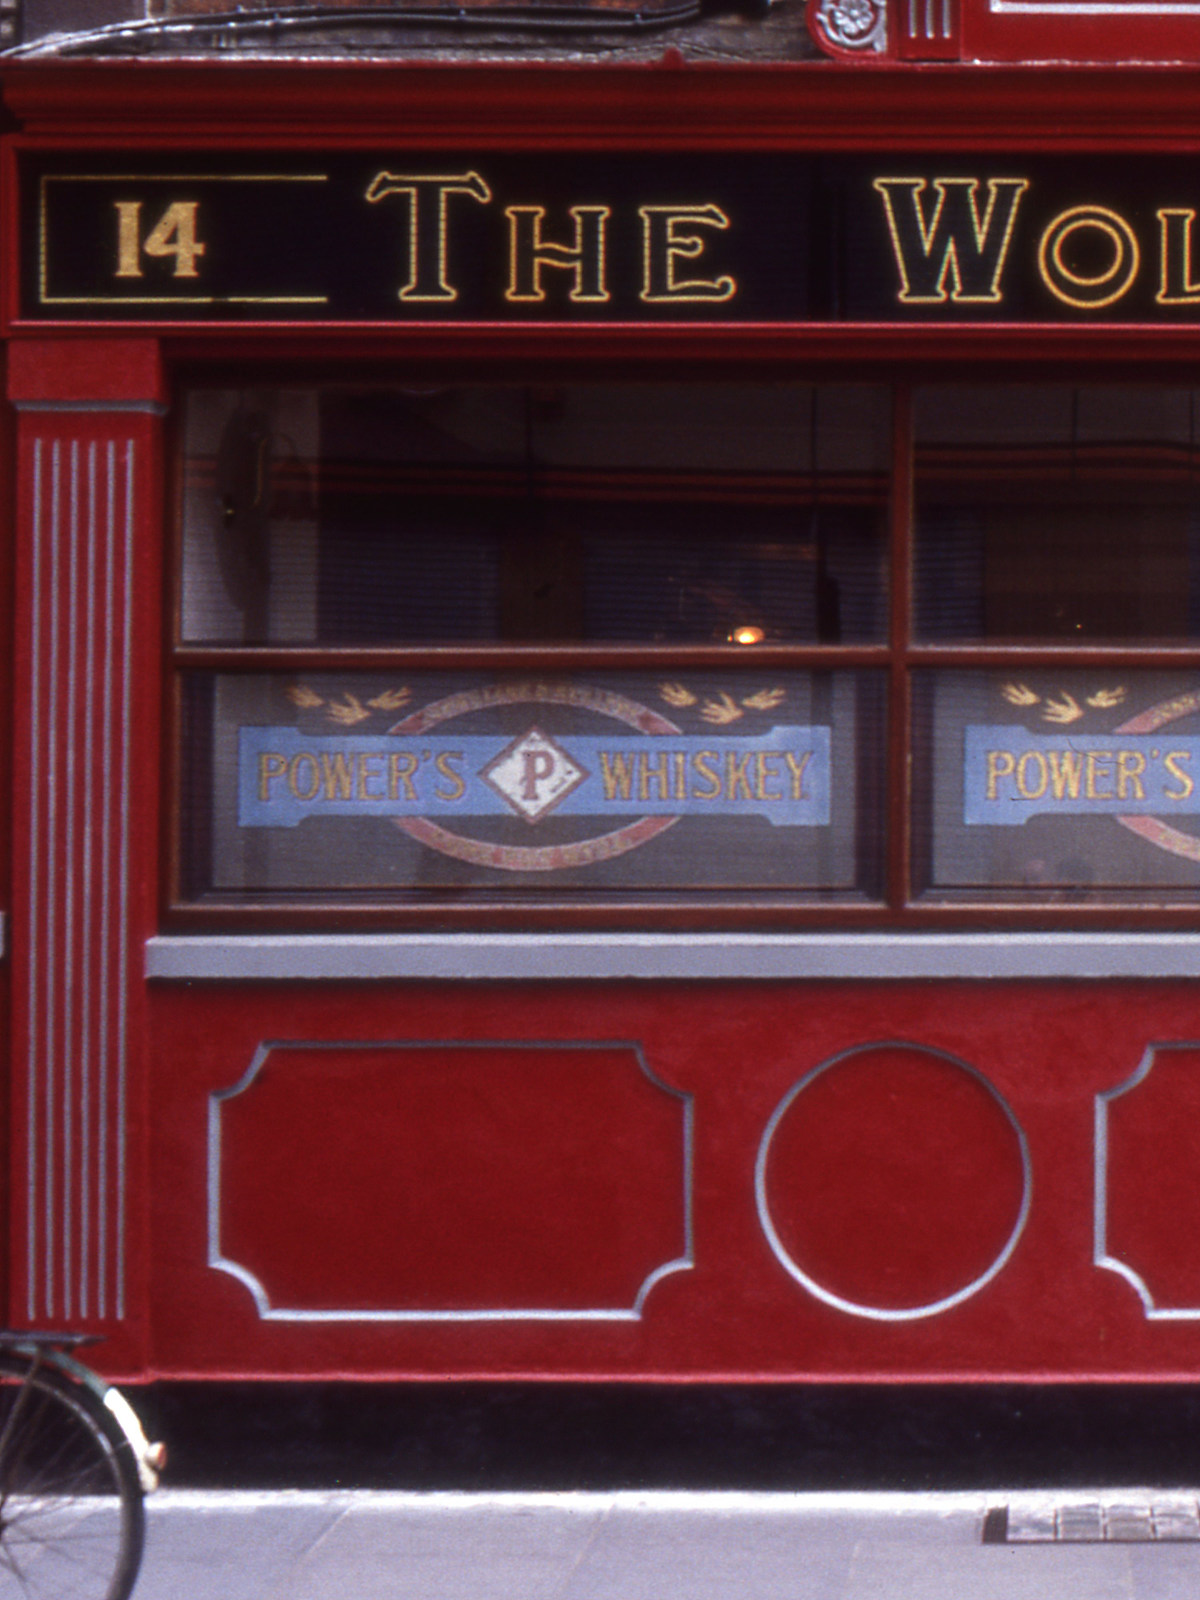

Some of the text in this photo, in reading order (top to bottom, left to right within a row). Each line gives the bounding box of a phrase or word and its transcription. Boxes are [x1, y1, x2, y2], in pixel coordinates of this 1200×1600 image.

[114, 201, 205, 277] 14
[365, 171, 736, 301] THE
[256, 749, 467, 803] POWER'S
[520, 750, 556, 802] P
[985, 749, 1195, 801] POWER'S
